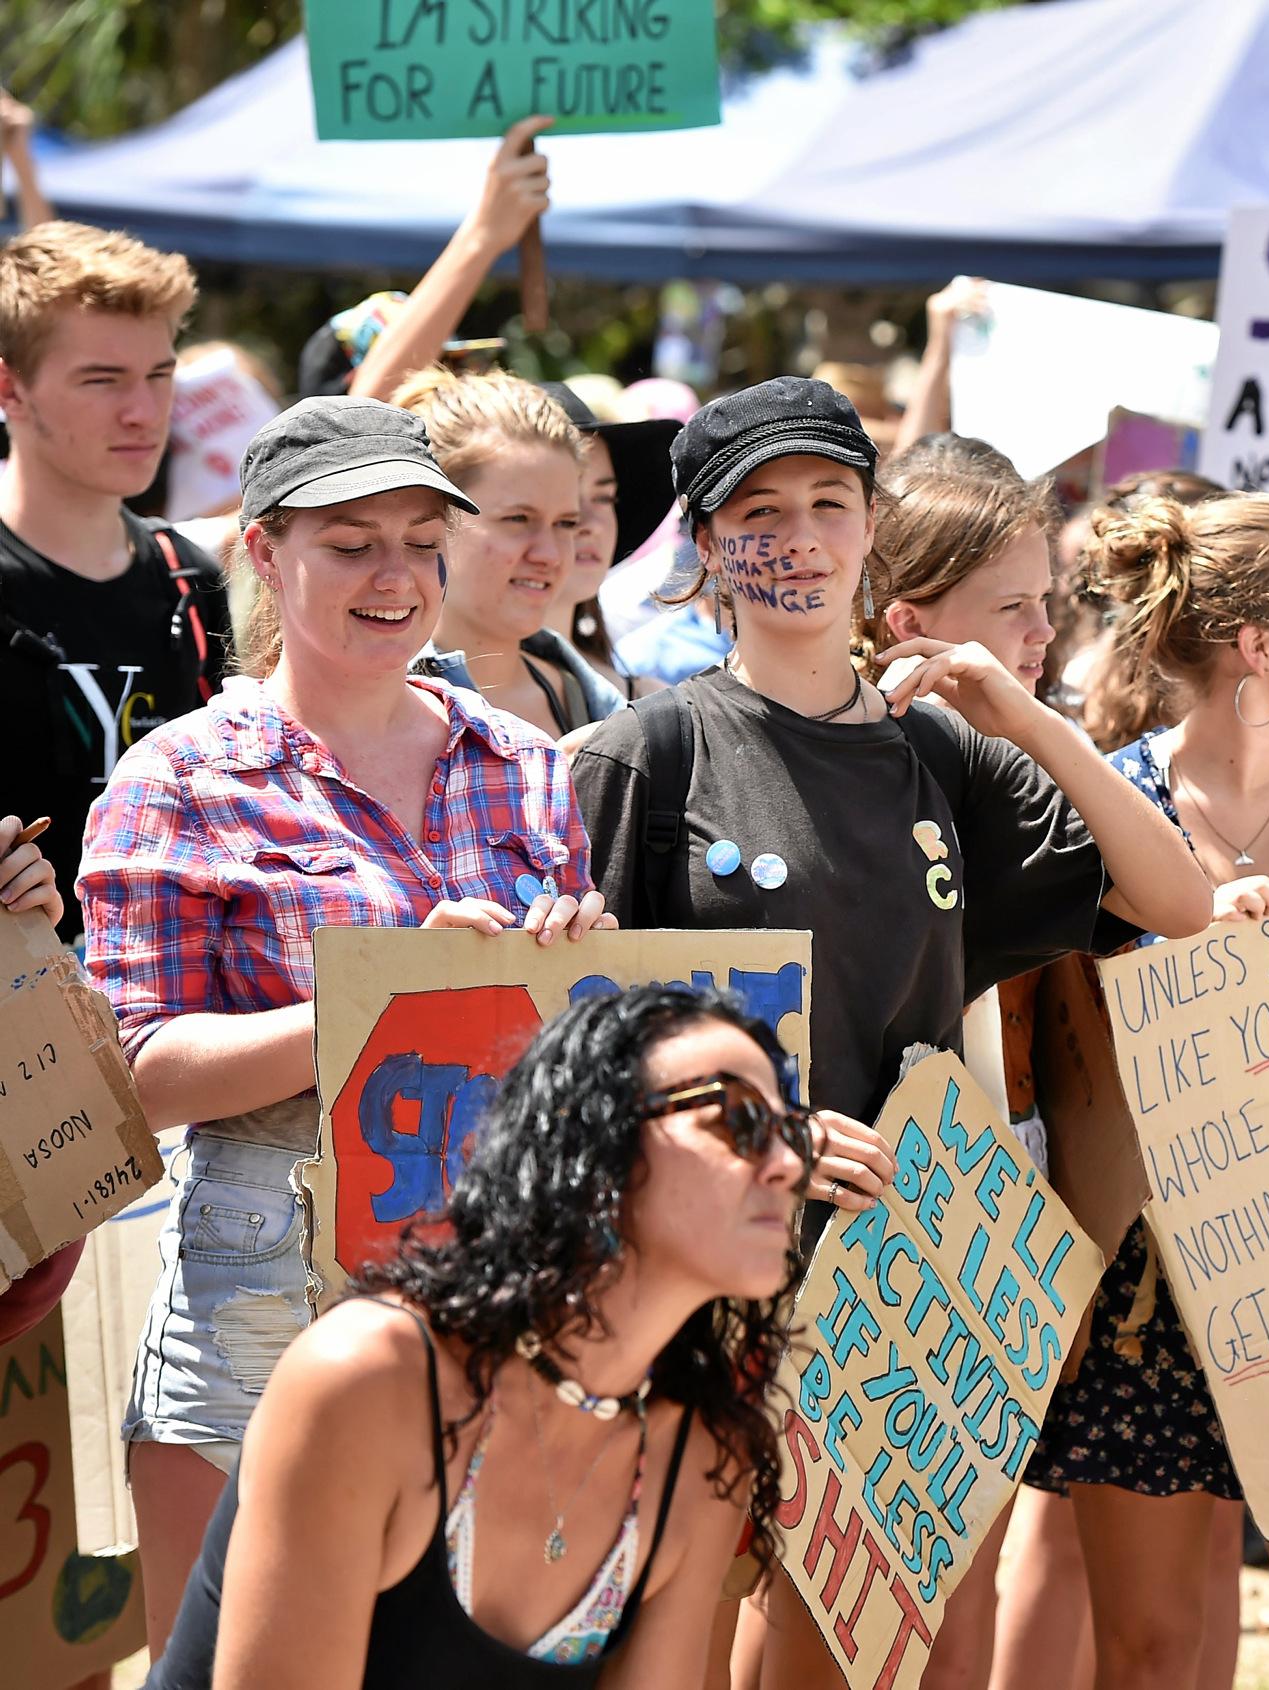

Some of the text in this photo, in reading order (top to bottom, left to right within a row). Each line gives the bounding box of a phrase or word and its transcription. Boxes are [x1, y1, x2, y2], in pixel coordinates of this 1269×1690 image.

[340, 56, 668, 125] FOR A FUTURE
[467, 0, 672, 47] STRIKING
[719, 534, 777, 558] VOTE
[1115, 935, 1248, 1034] UNLESS
[23, 1109, 94, 1170] NOOSA
[1132, 1029, 1216, 1114] LIKE
[892, 1115, 1063, 1391] BE LESS
[937, 1075, 1075, 1318] WE'LL
[815, 1266, 979, 1538] IF YOU'LL
[839, 1196, 1042, 1482] ACTIVIST
[773, 1408, 934, 1690] SHIT
[799, 1351, 954, 1604] BE LESS
